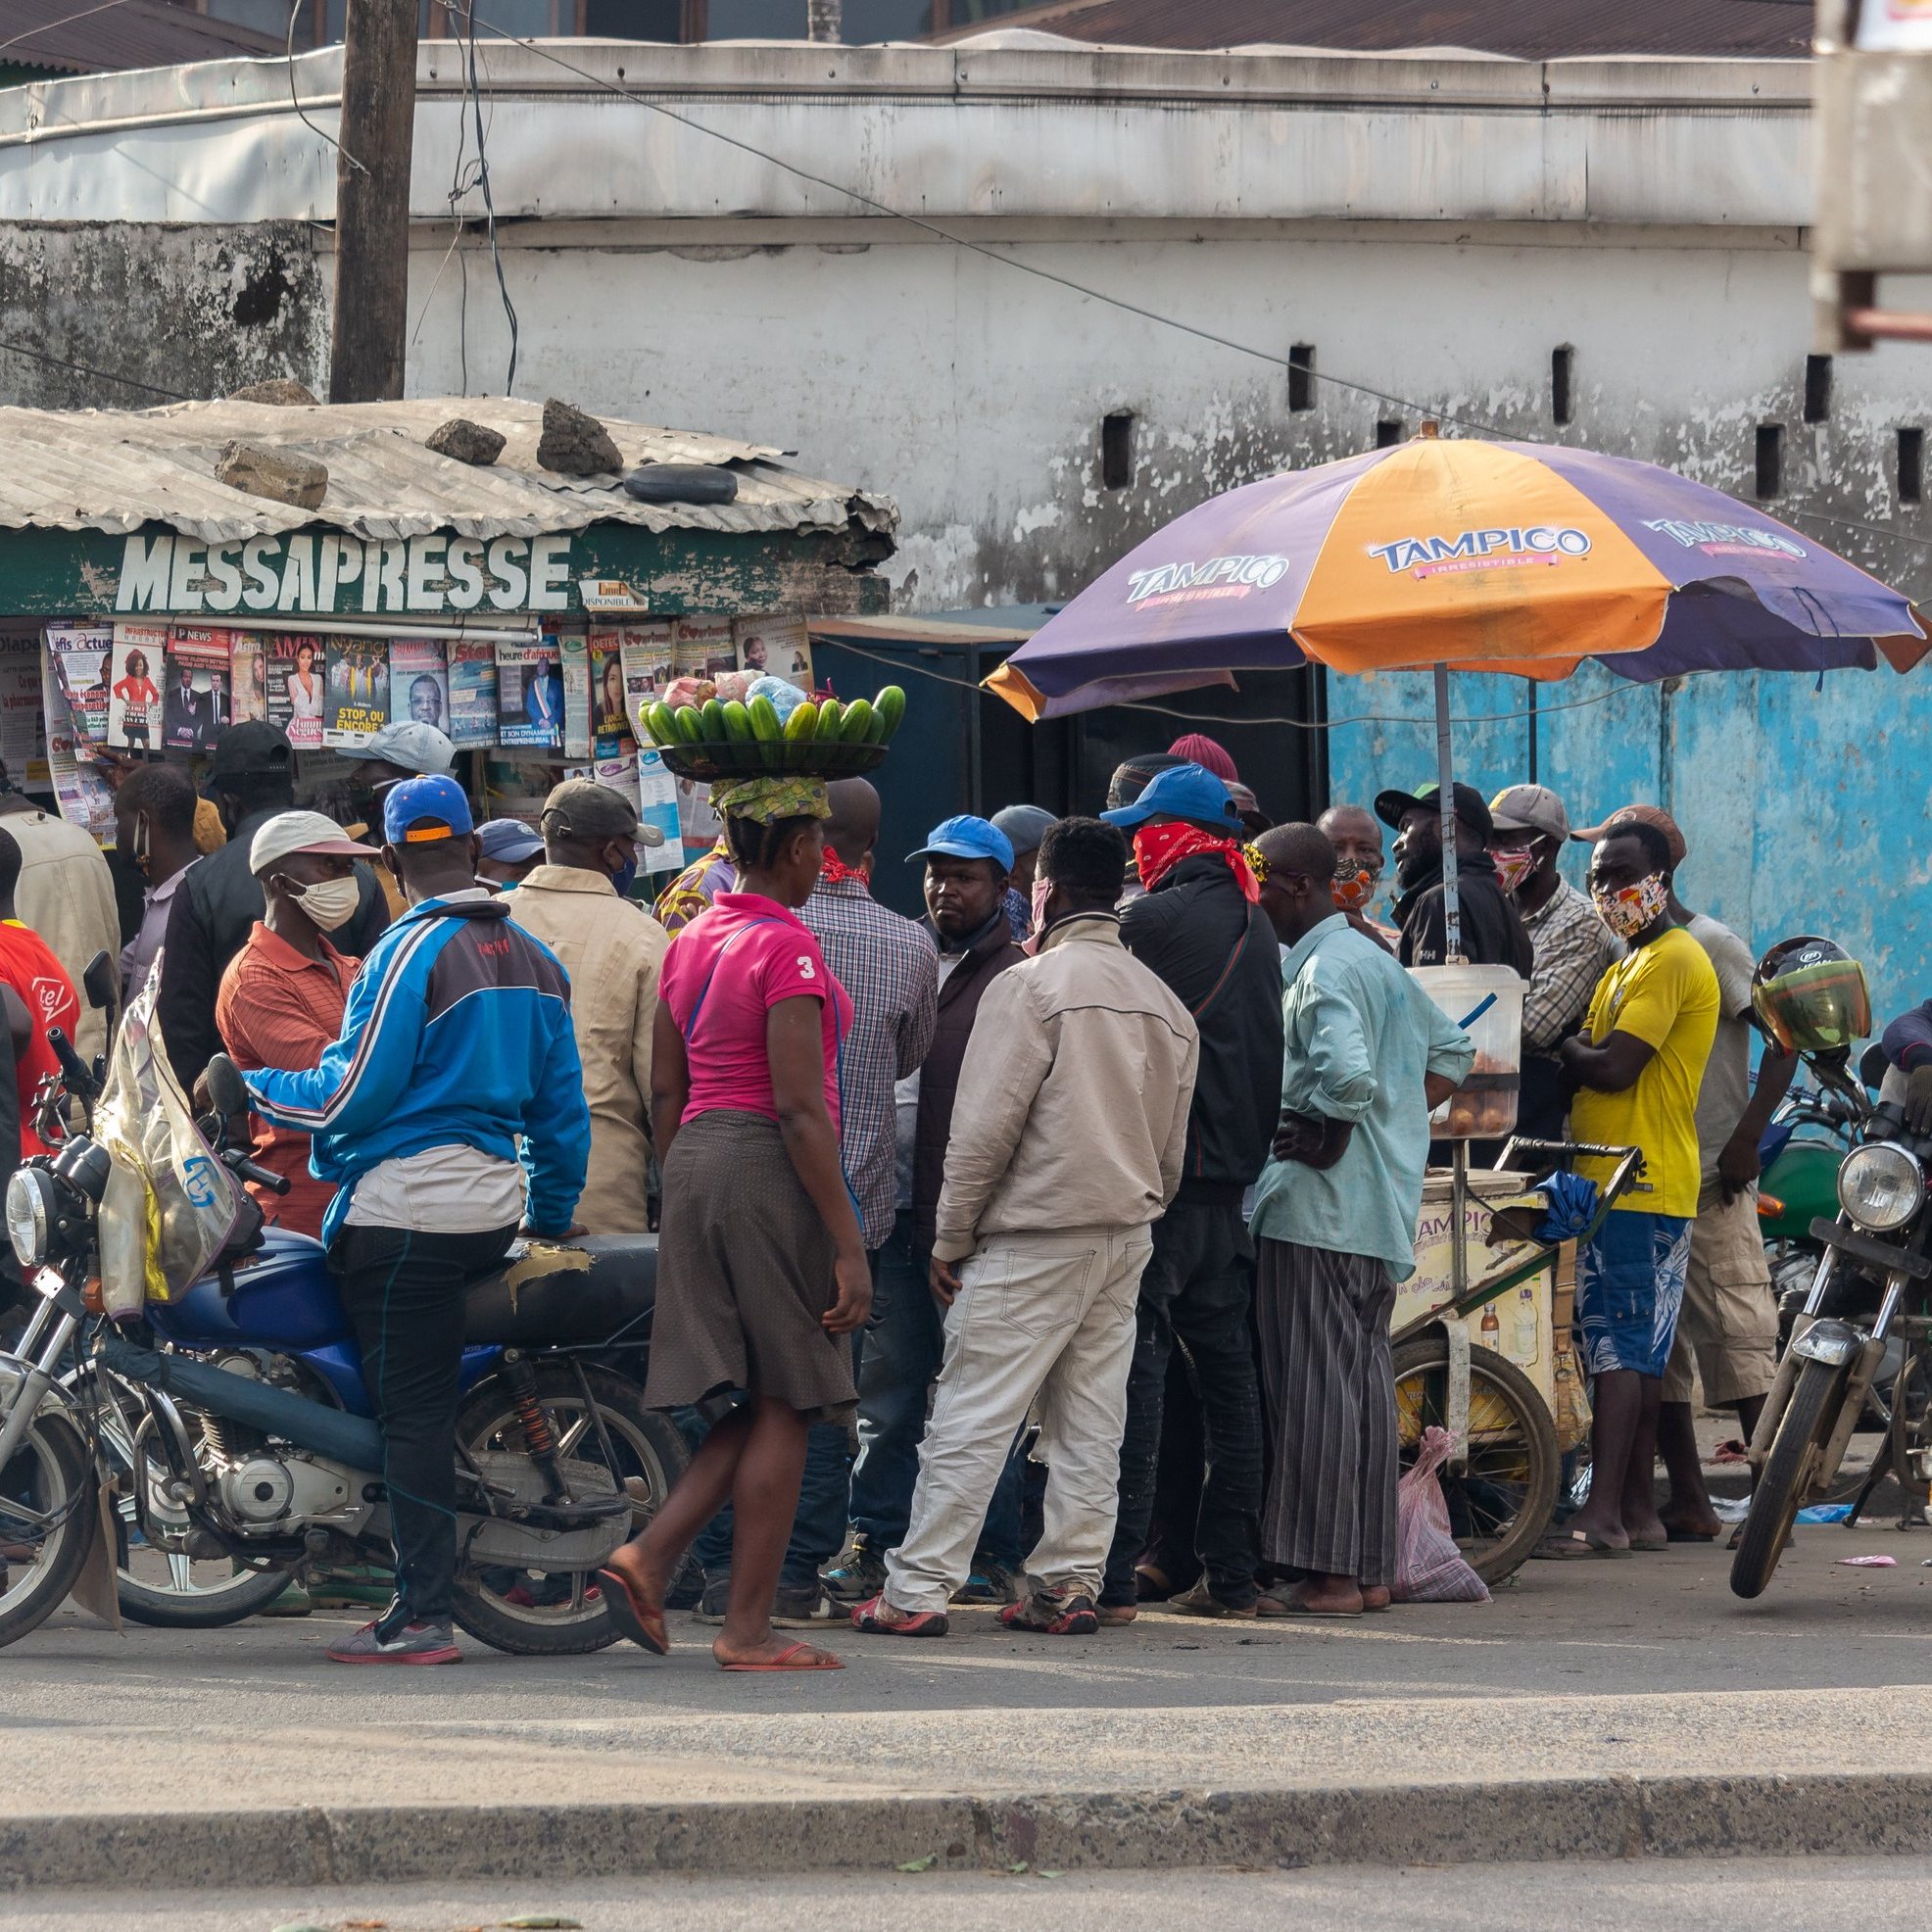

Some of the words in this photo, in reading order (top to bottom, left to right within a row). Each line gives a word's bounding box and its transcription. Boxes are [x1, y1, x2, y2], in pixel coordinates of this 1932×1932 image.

[1646, 519, 1808, 558] TAMPICO
[1369, 527, 1592, 573] TAMPICO
[115, 535, 571, 612] MESSAPRESSE
[1431, 557, 1535, 574] IRRESISTIBLE
[1127, 555, 1289, 604] TAMPICO
[187, 630, 212, 643] NEWS
[499, 649, 522, 660] heure
[370, 710, 384, 722] OU
[336, 719, 378, 733] ENCORE
[1420, 949, 1436, 960] HH
[797, 956, 815, 979] 3
